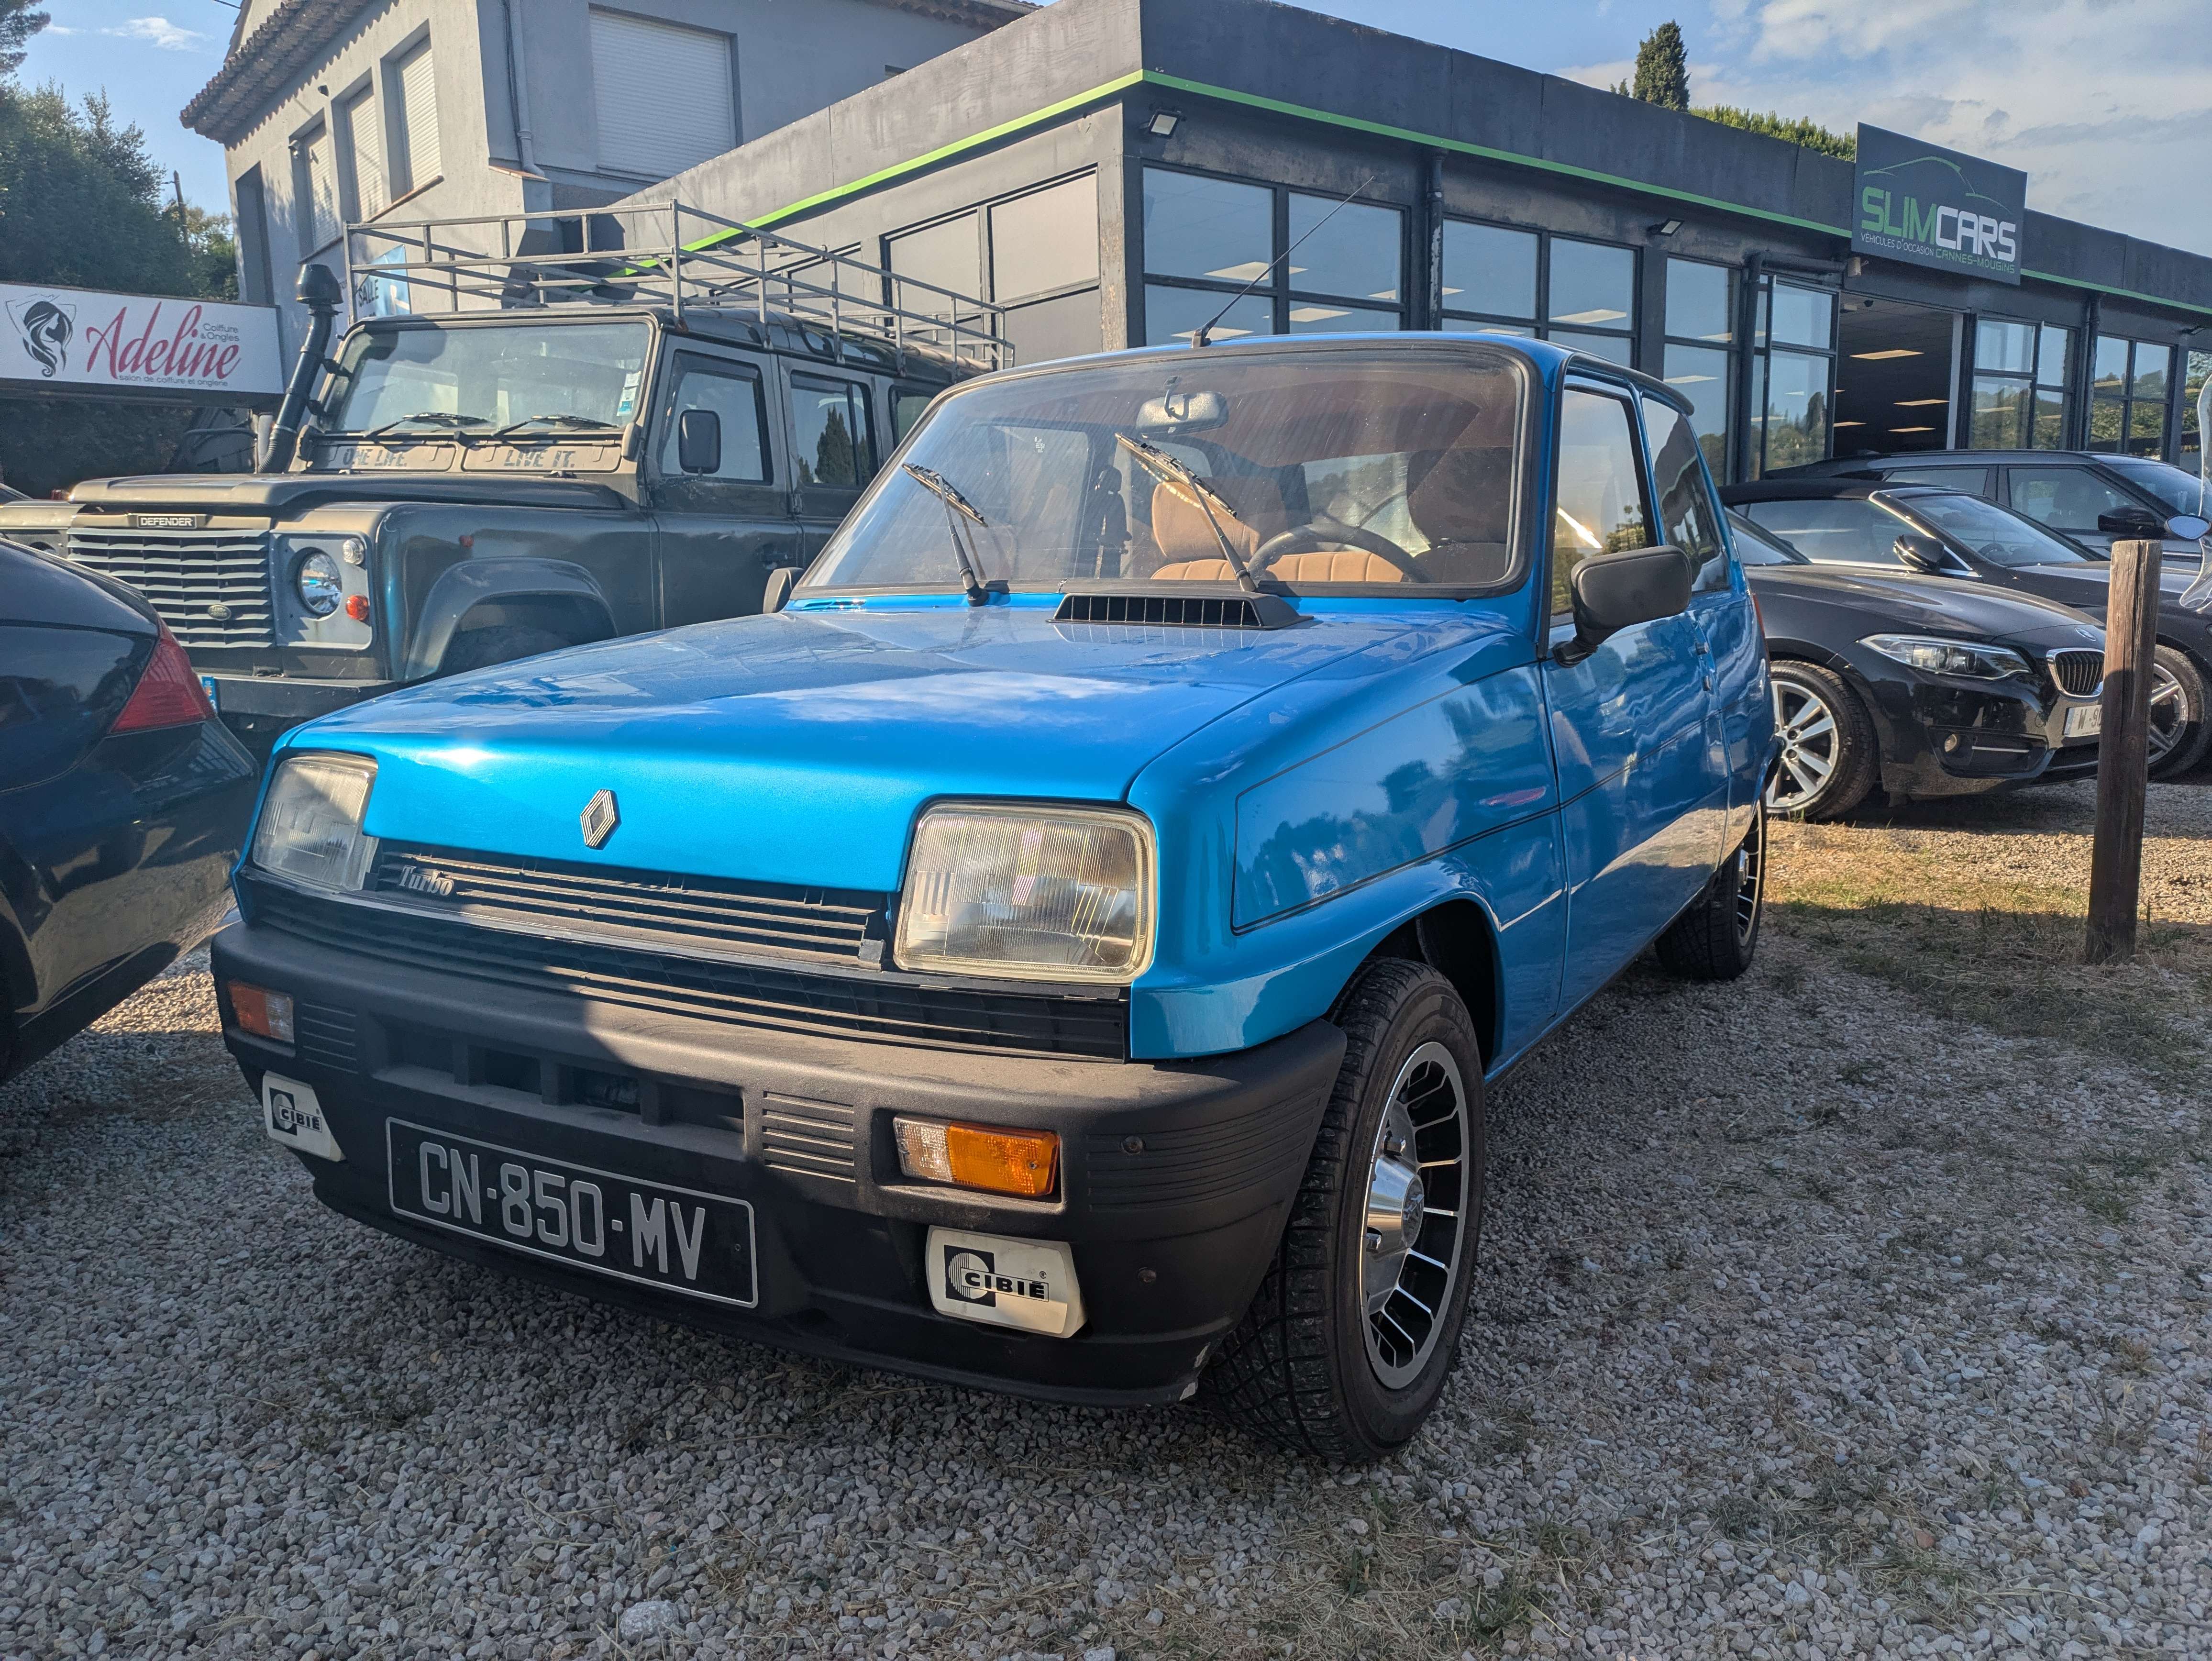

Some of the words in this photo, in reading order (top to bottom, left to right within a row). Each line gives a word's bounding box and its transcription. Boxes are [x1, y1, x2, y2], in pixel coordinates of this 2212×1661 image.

[1861, 232, 1895, 248] VÉHICULES
[1897, 239, 1934, 256] D'OCCASION
[1936, 248, 2015, 274] CANNES-MOUGINS
[203, 323, 239, 333] Coiffure
[86, 301, 241, 379] Adeline
[156, 376, 185, 384] coiffure
[343, 448, 373, 466] ONE
[504, 449, 548, 467] LIVE
[140, 517, 192, 526] DEFENDER
[399, 864, 454, 896] Turbo
[420, 1141, 706, 1280] CN-850-MV
